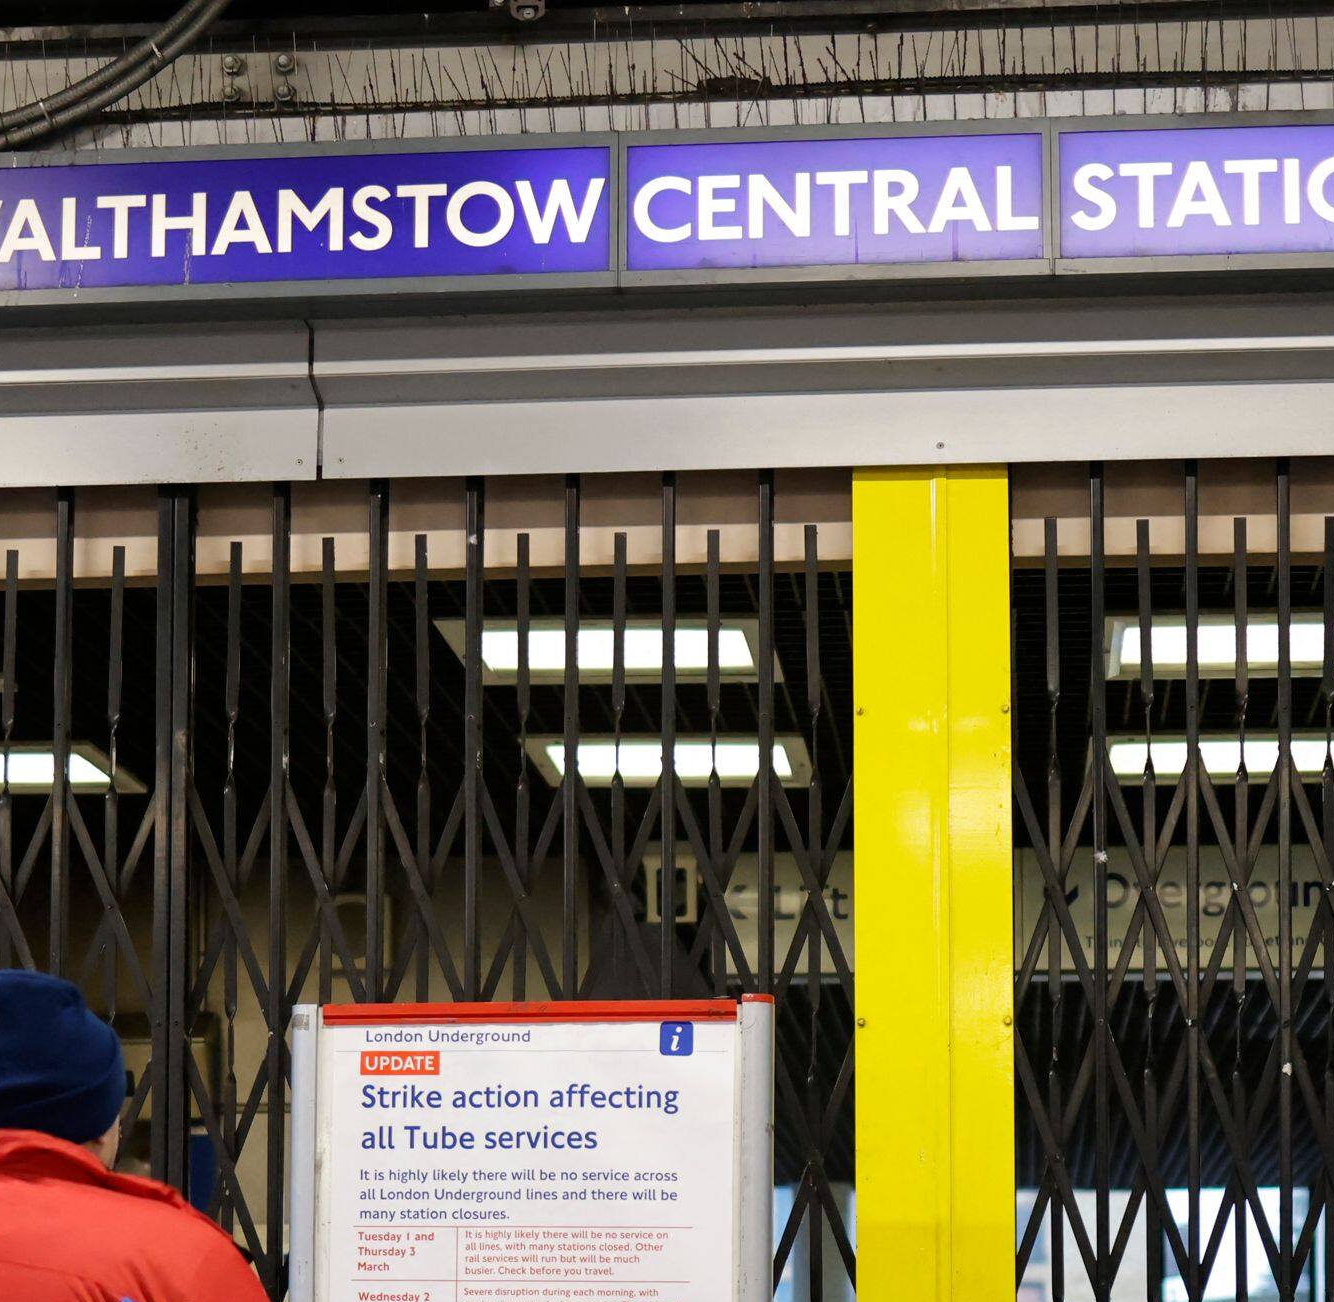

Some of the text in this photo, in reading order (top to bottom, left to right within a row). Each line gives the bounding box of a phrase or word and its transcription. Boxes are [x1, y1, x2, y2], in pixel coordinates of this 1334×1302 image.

[631, 165, 1040, 244] CENTRAL
[366, 1030, 530, 1043] London Underground
[365, 1056, 435, 1071] UPDATE
[361, 1084, 679, 1114] Strike action affecting
[361, 1125, 597, 1149] all Tube services
[360, 1168, 677, 1183] It is highly likely there will be no service across
[360, 1188, 677, 1203] all London Underground lines and there will be
[360, 1207, 509, 1222] many station closures.
[357, 1231, 434, 1243] Tuesday 1 and
[465, 1230, 472, 1239] It
[475, 1230, 482, 1238] is
[484, 1229, 511, 1240] highly
[514, 1229, 539, 1240] likely
[542, 1230, 568, 1239] there
[570, 1229, 588, 1238] will
[590, 1230, 602, 1238] be
[619, 1230, 653, 1239] service
[357, 1246, 415, 1258] Thursday 3
[465, 1242, 663, 1252] all lines, with many stations closed. Other
[357, 1261, 389, 1271] March
[358, 1292, 429, 1302] Wednesday 2
